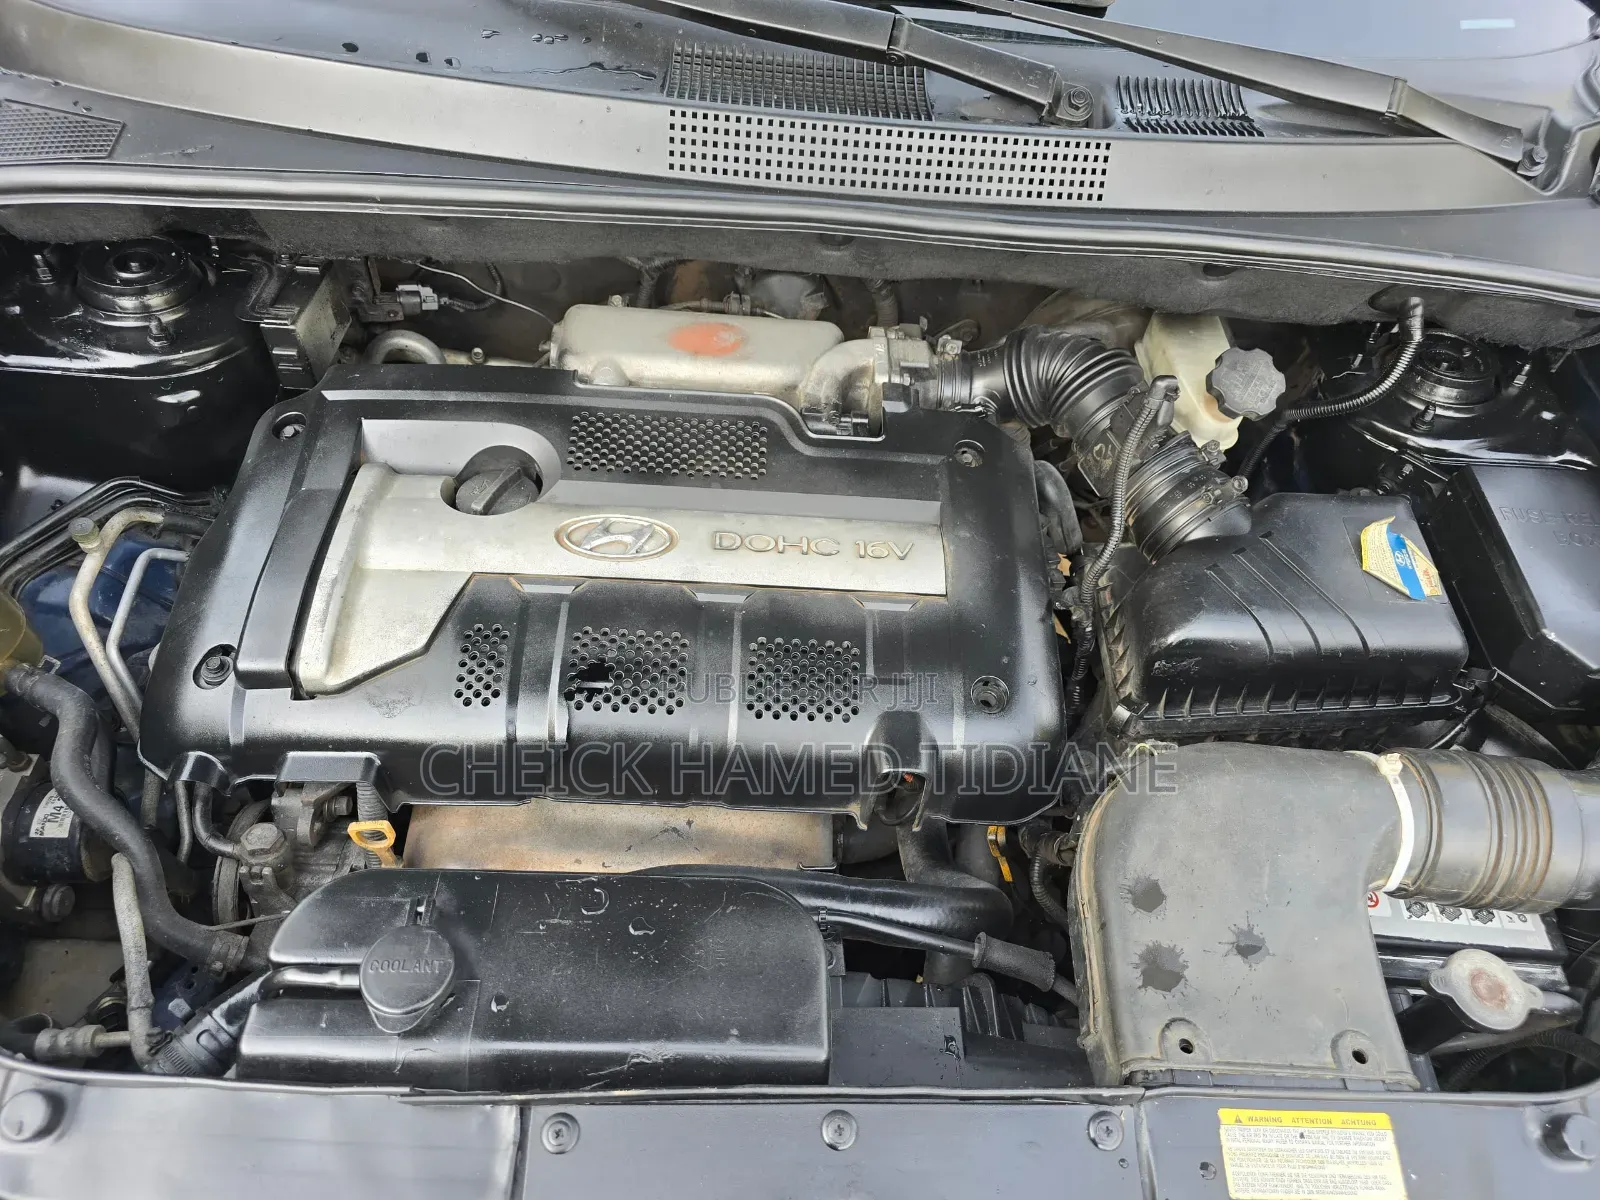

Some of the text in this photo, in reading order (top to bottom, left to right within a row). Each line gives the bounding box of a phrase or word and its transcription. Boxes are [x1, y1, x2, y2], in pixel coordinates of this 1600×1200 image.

[712, 530, 915, 560] DOHC 16V
[368, 958, 444, 974] COOLANT
[1248, 1116, 1283, 1124] WARNING
[1341, 1118, 1377, 1126] ACHTUNG
